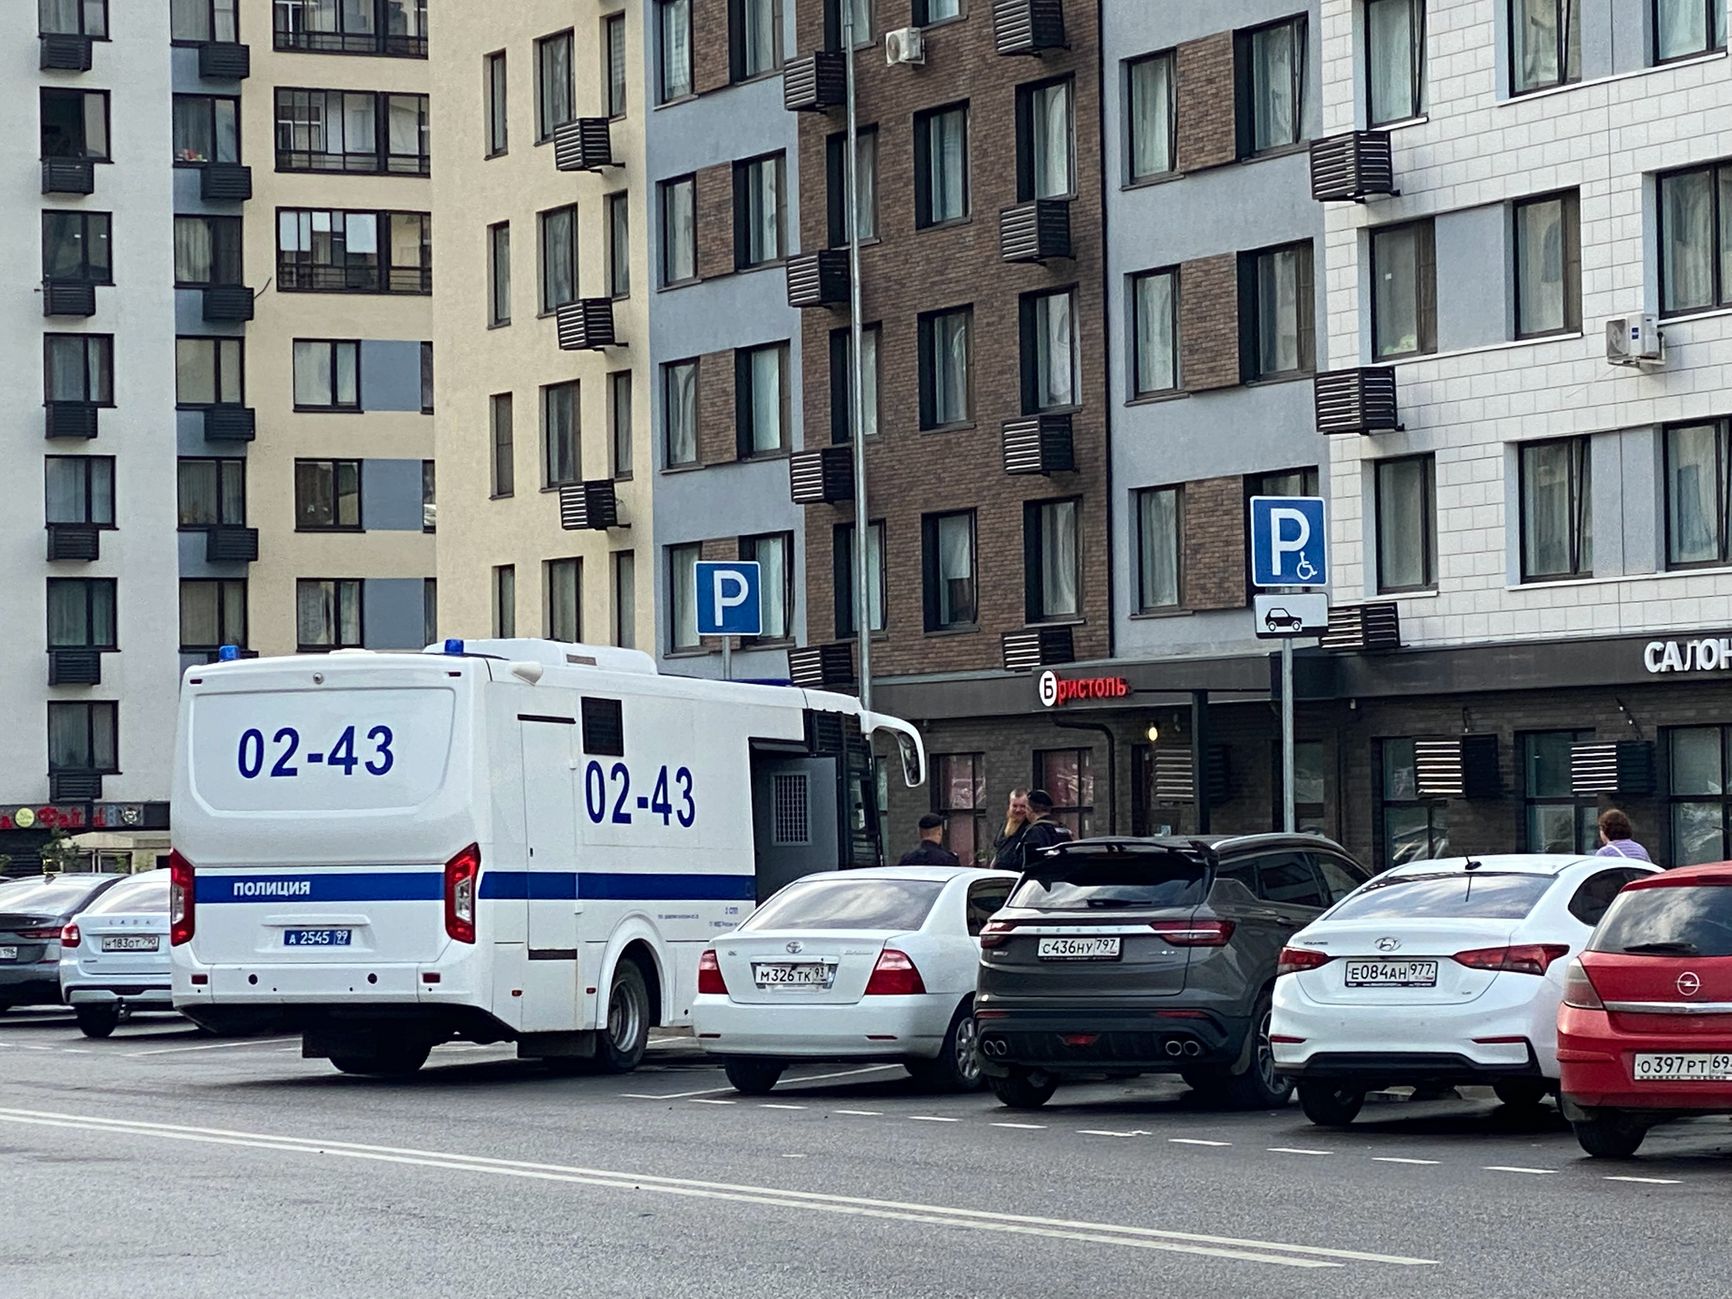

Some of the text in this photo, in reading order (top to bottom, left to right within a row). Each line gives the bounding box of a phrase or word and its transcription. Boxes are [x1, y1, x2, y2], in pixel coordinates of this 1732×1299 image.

[1270, 507, 1311, 576] P
[713, 569, 749, 627] P
[1643, 638, 1732, 674] САЛОН
[1040, 672, 1127, 705] Бристоль
[238, 724, 395, 779] 02-43
[585, 760, 696, 828] 02-43
[233, 881, 311, 897] ПОЛИЦИЯ
[299, 931, 331, 945] 2545
[1095, 939, 1116, 950] 797
[813, 967, 825, 979] 93
[1409, 963, 1432, 977] 977
[1712, 1055, 1730, 1070] 69
